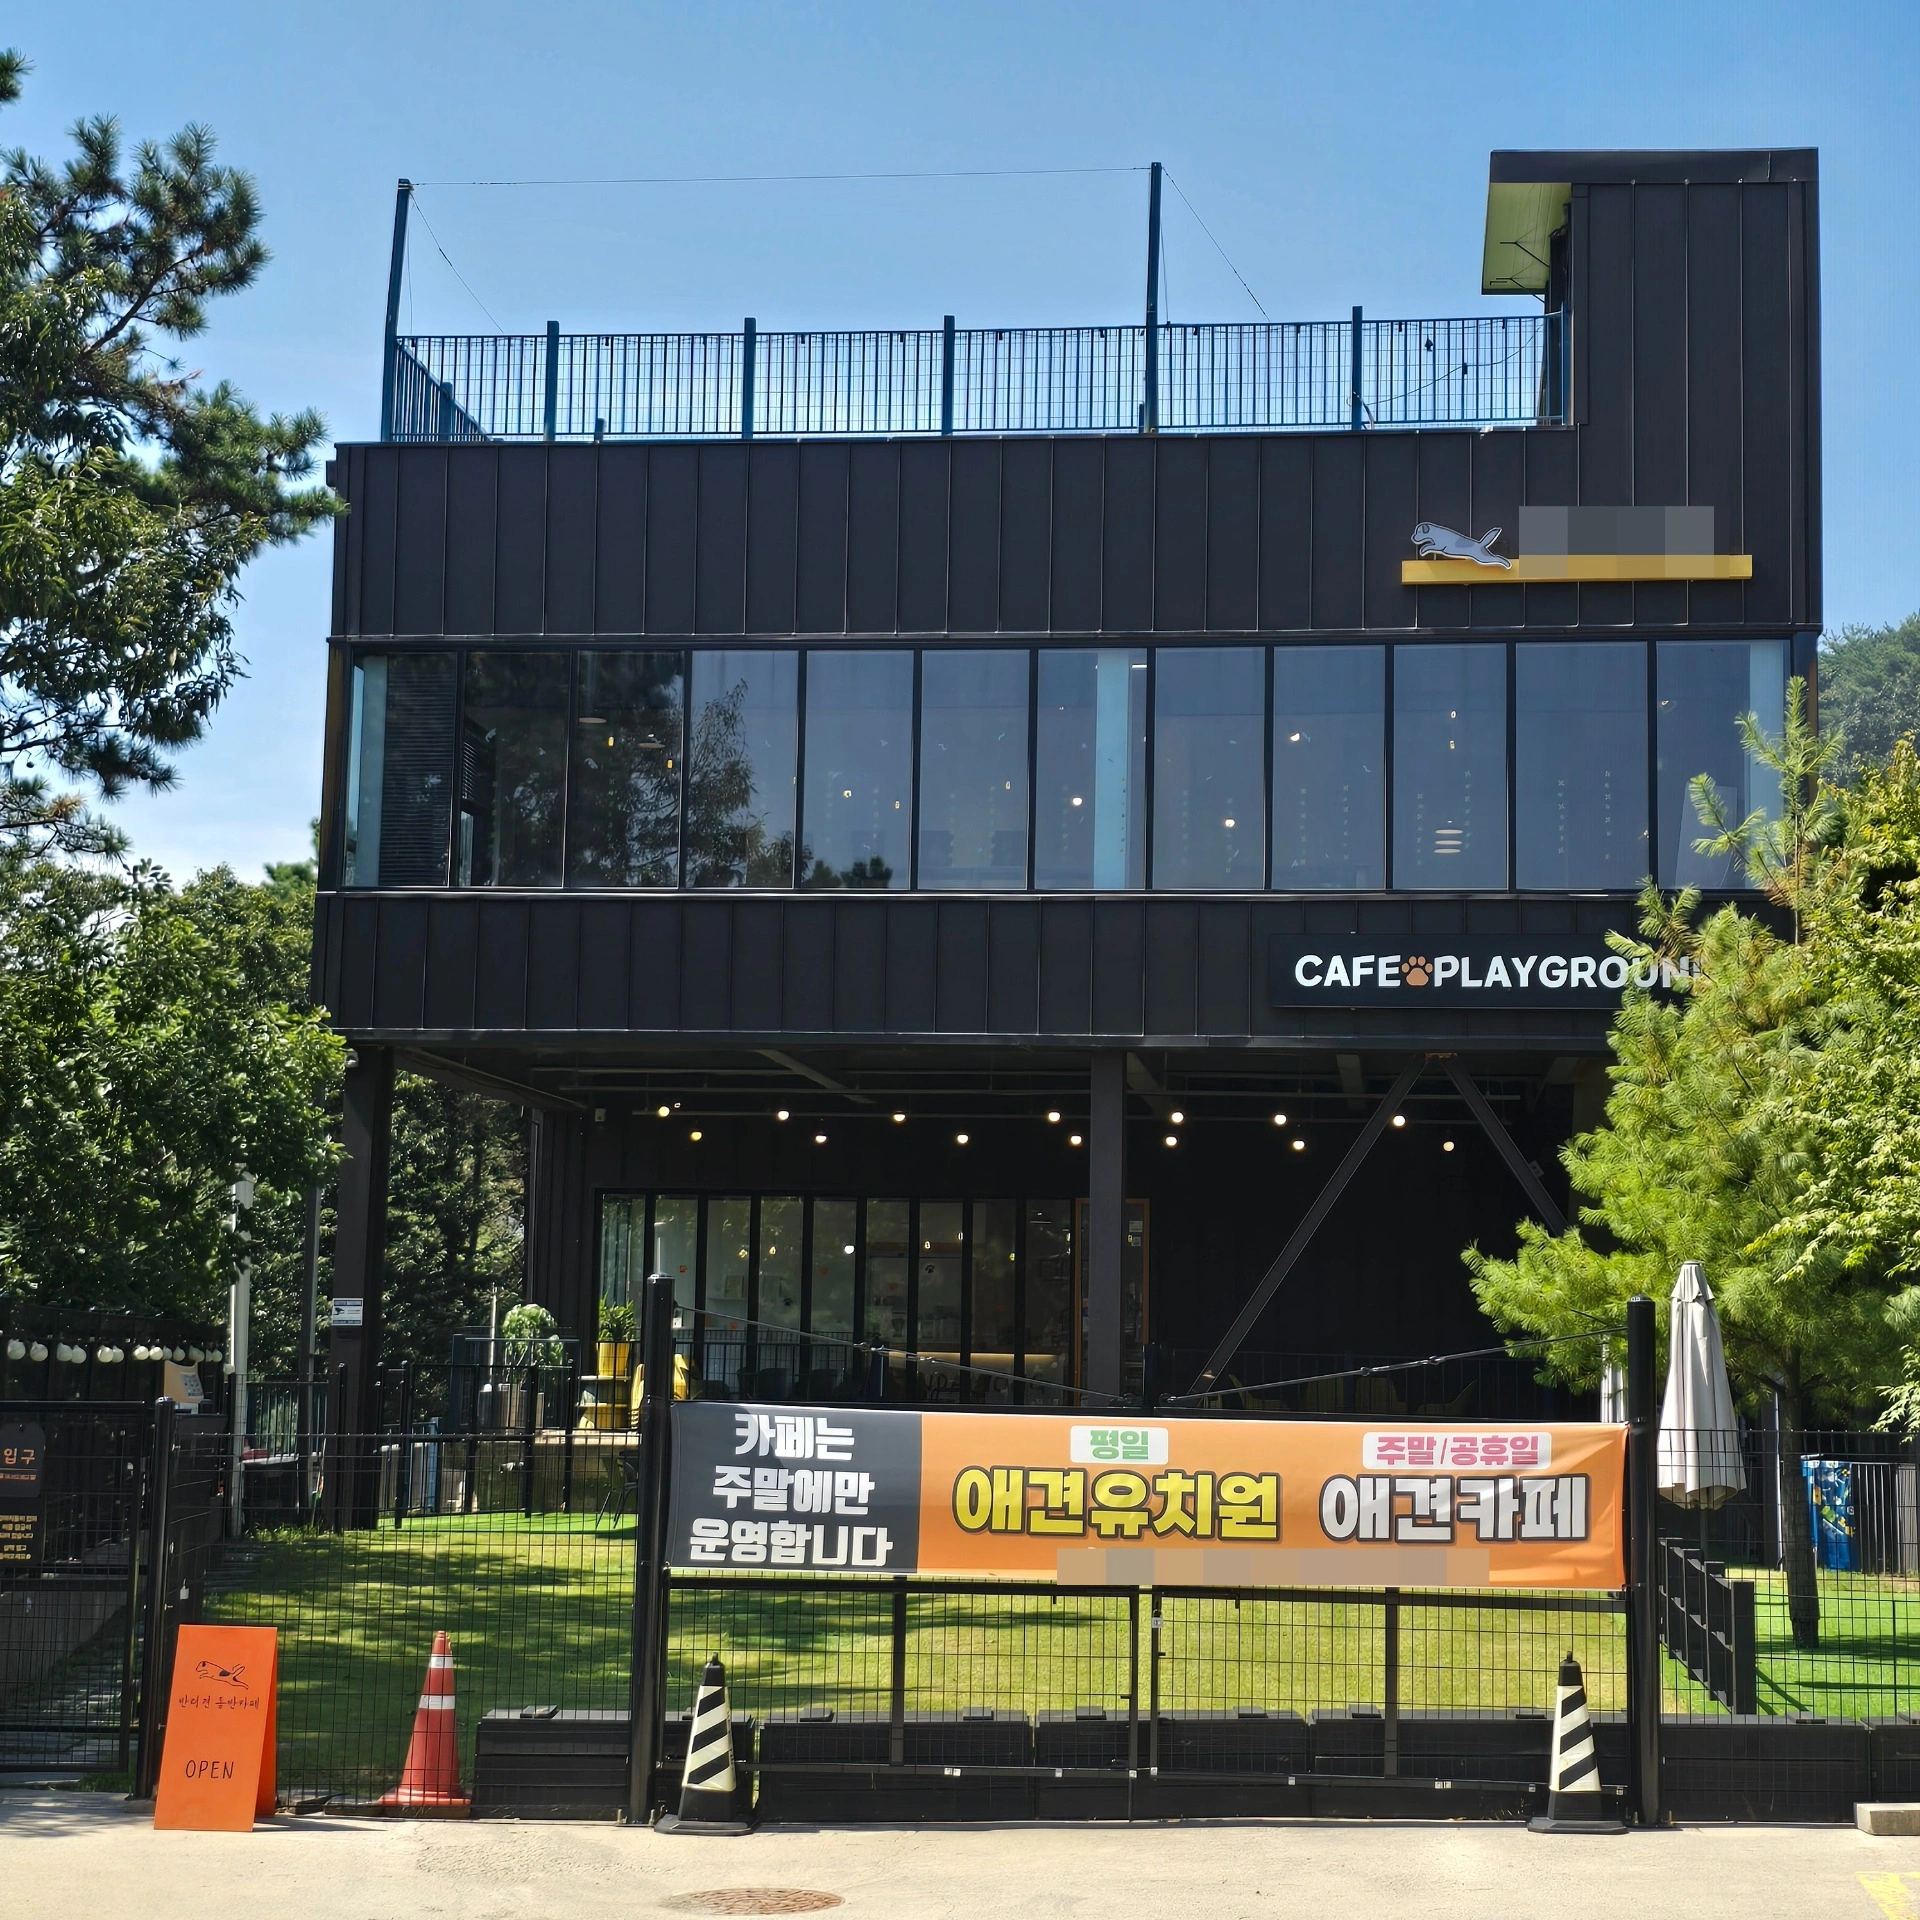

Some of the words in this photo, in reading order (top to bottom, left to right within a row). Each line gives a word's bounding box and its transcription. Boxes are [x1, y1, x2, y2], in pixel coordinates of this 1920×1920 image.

[1295, 954, 1401, 987] CAFE
[1434, 955, 1702, 988] PLAYGROUN
[734, 1413, 855, 1461] 카페는
[1090, 1430, 1149, 1460] 평일
[712, 1465, 876, 1515] 주말에만
[953, 1466, 1281, 1541] 애견유치원
[1319, 1474, 1590, 1543] 애견카페
[689, 1517, 894, 1567] 운영합니다
[185, 1759, 235, 1779] OPEN
